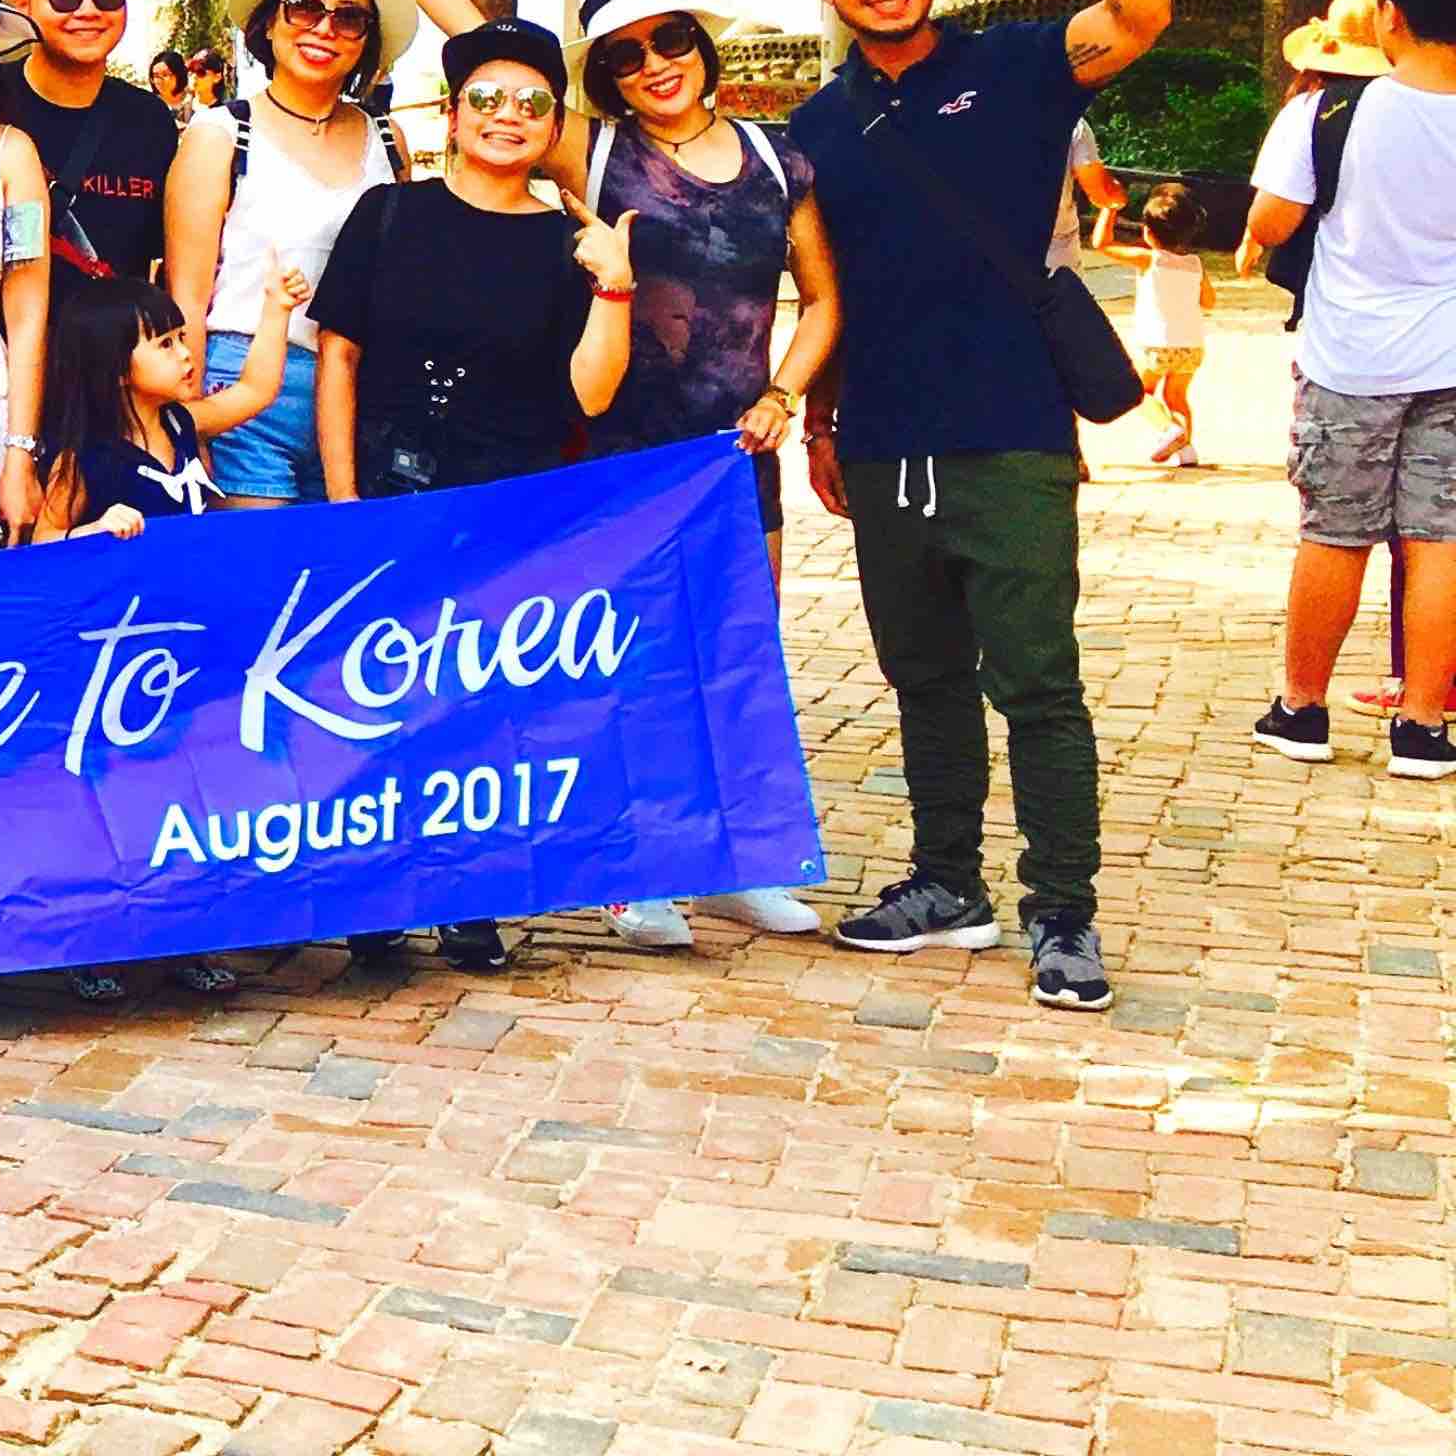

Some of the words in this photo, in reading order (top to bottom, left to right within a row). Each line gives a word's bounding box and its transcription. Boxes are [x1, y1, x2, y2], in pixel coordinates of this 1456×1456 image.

[83, 173, 153, 198] KILLER
[239, 560, 640, 752] Korea
[148, 773, 403, 873] August
[420, 755, 581, 838] 2017
